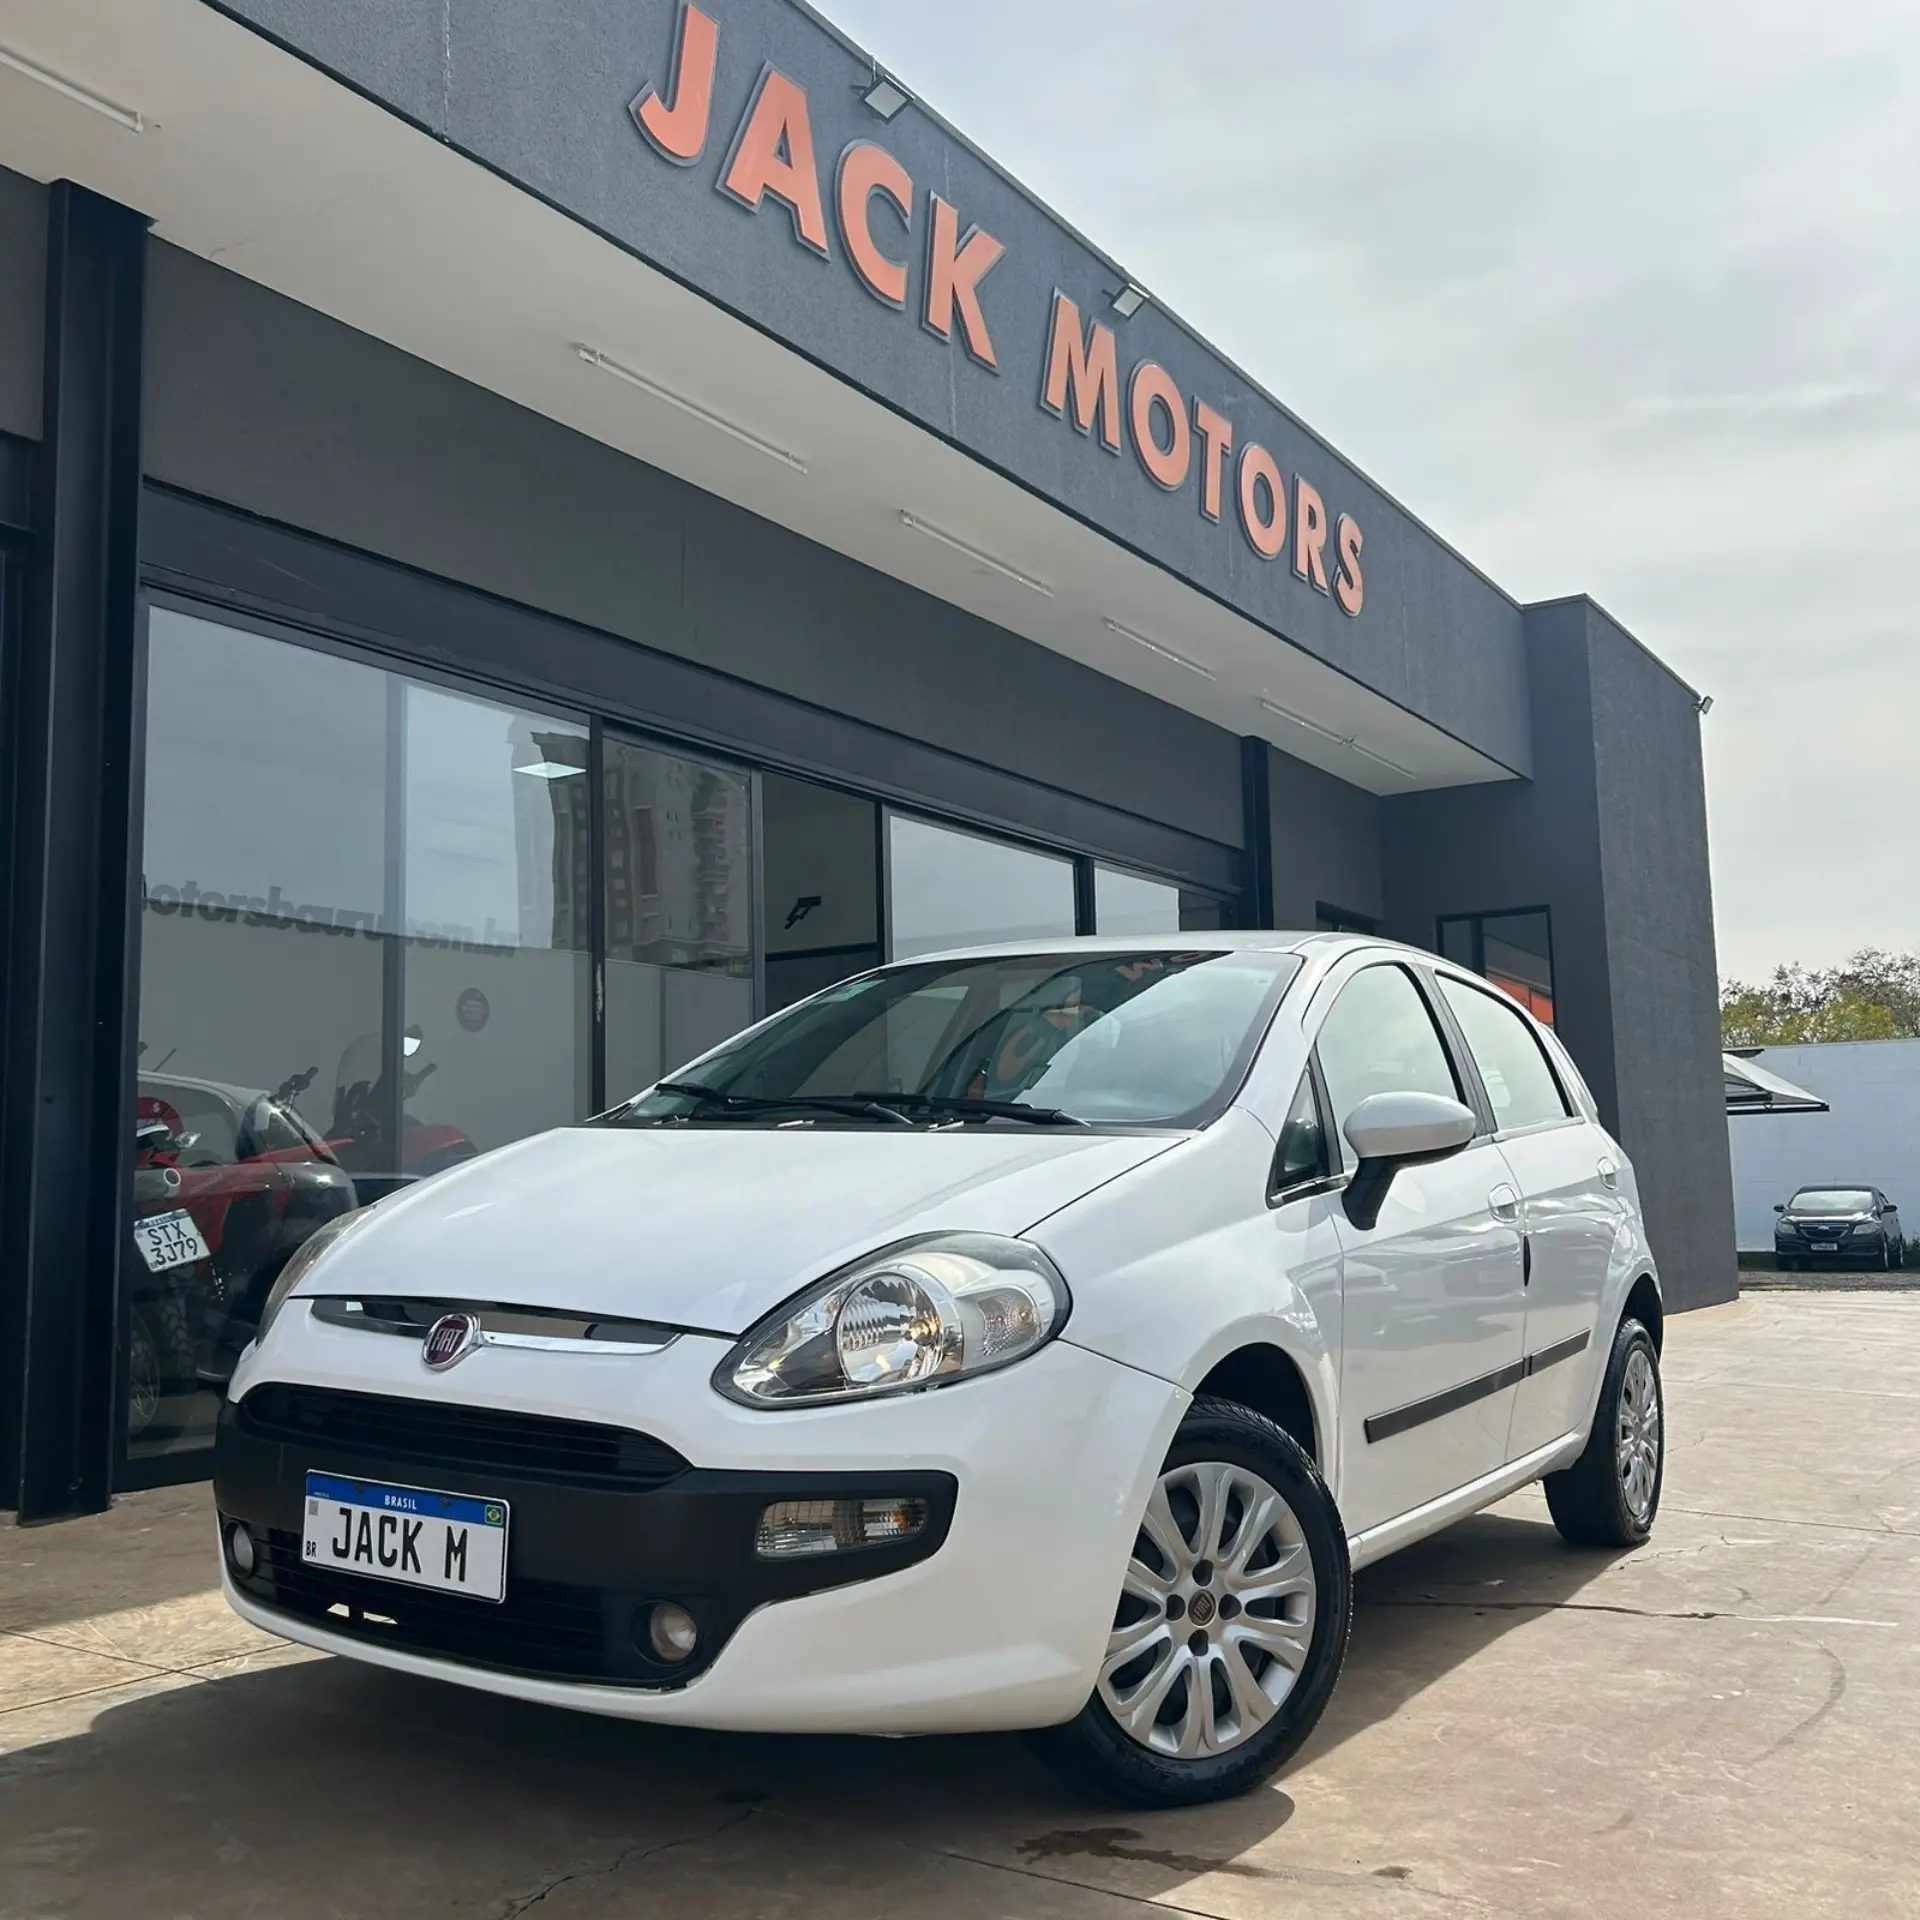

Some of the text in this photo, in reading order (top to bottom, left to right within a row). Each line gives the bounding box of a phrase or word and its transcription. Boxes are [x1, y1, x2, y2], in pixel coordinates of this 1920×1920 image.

[628, 2, 1366, 617] JACK MOTORS
[147, 1221, 187, 1246] STX
[150, 1237, 198, 1266] 3J79
[430, 1327, 464, 1353] FIAT
[384, 1493, 417, 1511] BRASIL
[305, 1540, 317, 1558] BR
[331, 1506, 469, 1583] JACK M
